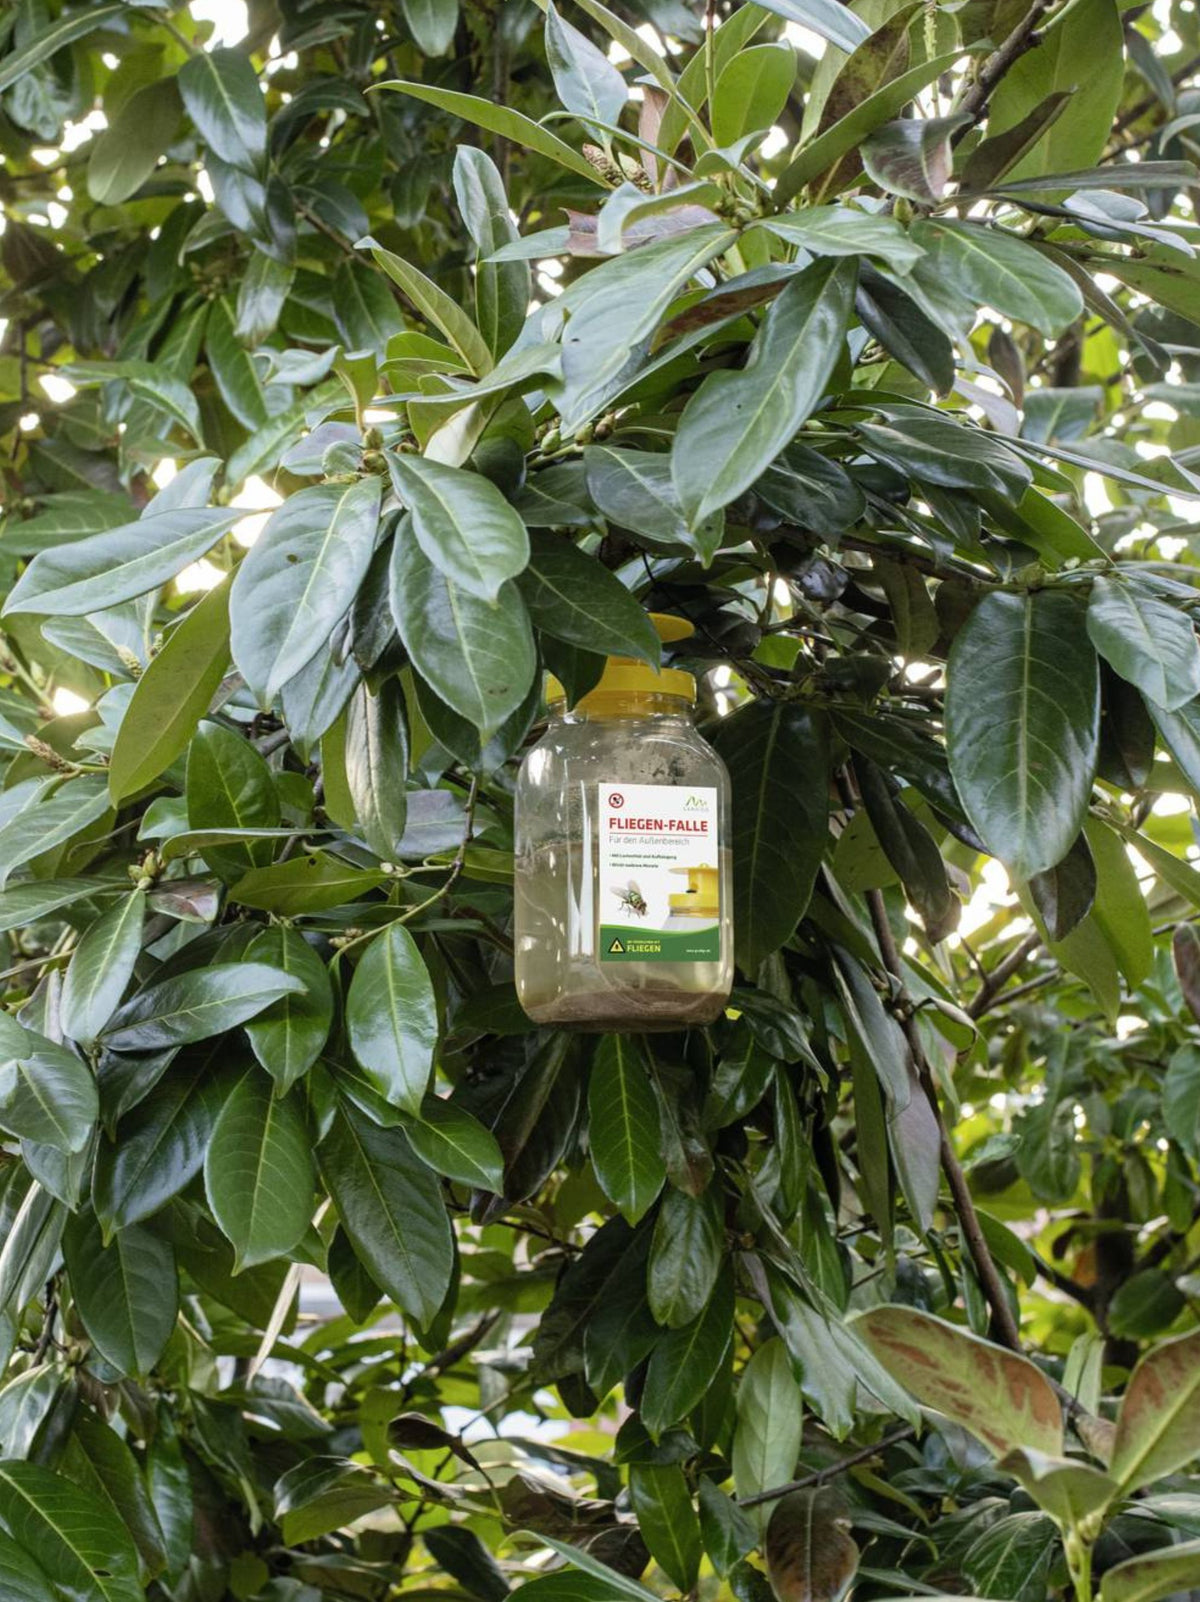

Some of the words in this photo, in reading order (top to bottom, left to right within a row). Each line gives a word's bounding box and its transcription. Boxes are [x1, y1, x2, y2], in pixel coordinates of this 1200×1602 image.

[609, 817, 708, 832] FLIEGEN-FALLE
[609, 835, 622, 845] Für
[623, 836, 637, 845] den
[640, 836, 690, 846] Außenbereich
[627, 944, 661, 953] FLIEGEN
